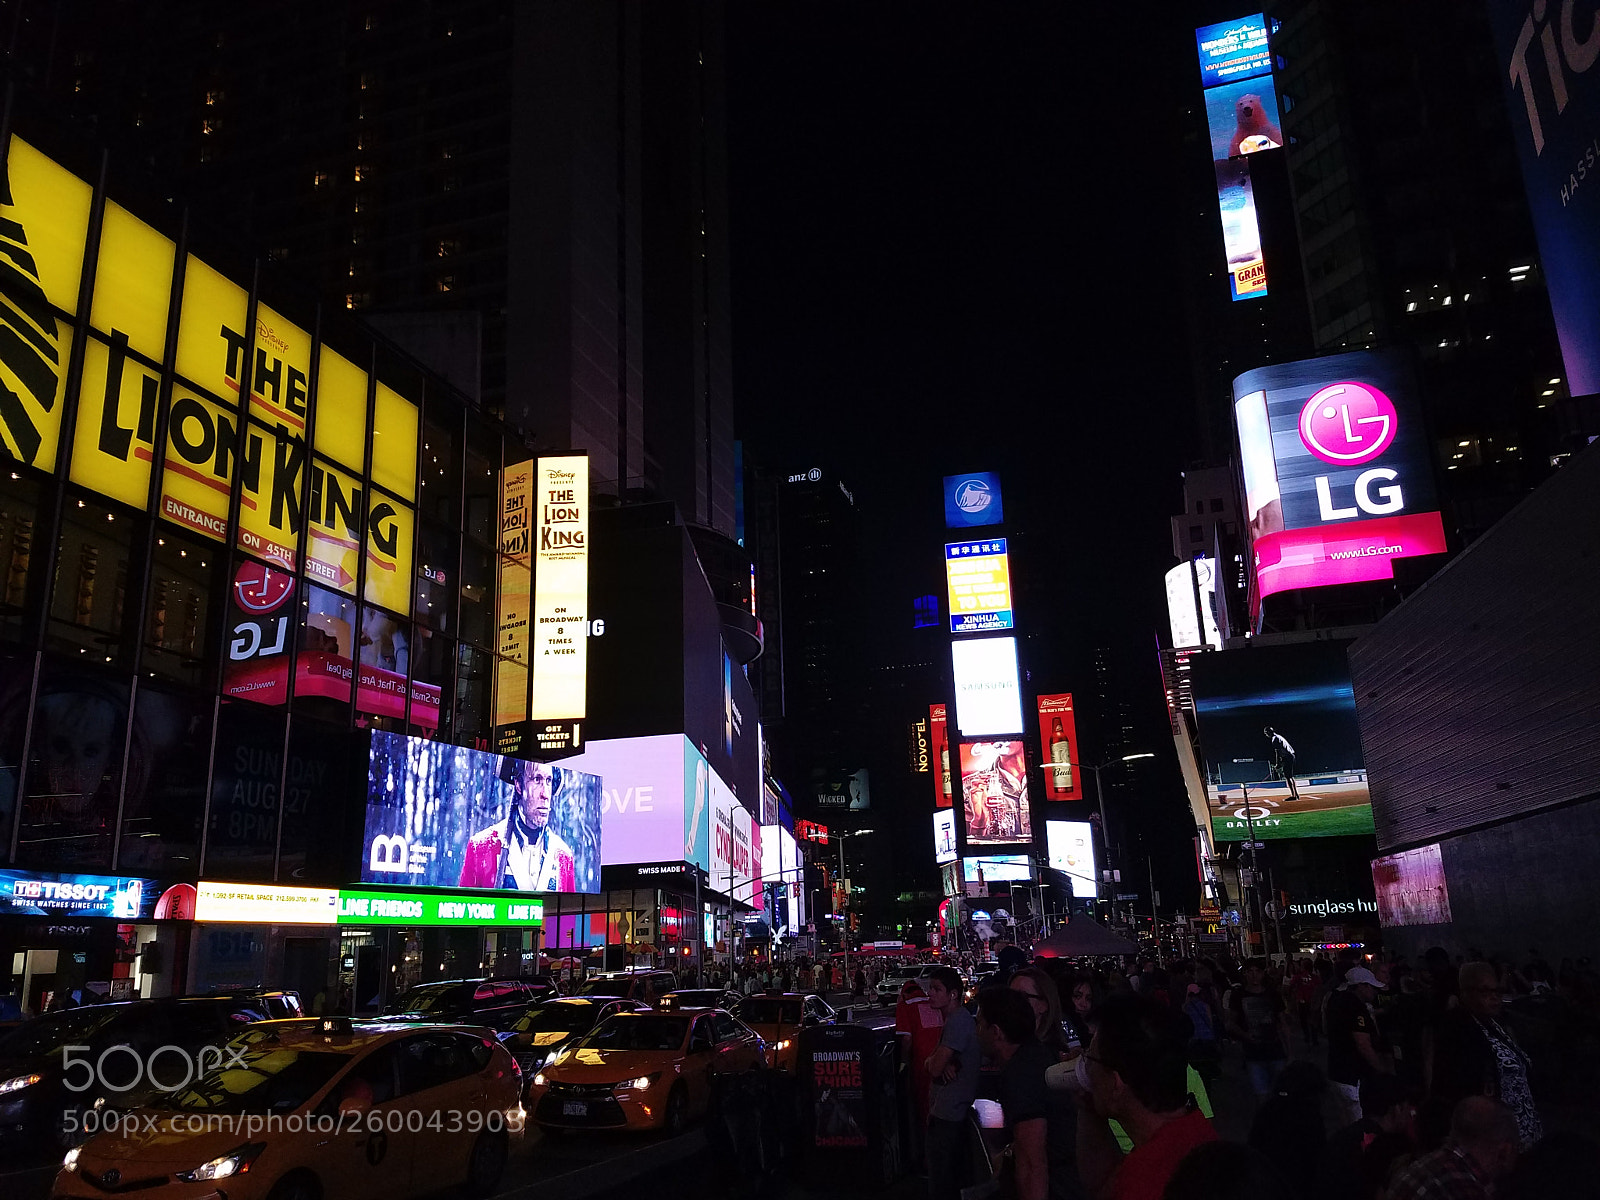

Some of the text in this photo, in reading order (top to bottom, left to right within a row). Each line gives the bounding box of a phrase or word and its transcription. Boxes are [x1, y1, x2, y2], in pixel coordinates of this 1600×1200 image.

[220, 324, 307, 418] THE
[98, 326, 262, 494] LION
[545, 469, 576, 480] Disney
[268, 421, 399, 560] KING
[548, 489, 574, 502] THE
[1314, 467, 1405, 522] LG
[544, 504, 579, 525] LION
[166, 499, 337, 580] ENTRANCE ON 45TH STREET
[541, 526, 584, 551] KING
[1330, 544, 1403, 561] www.LG.com
[539, 616, 584, 624] BROADWAY
[963, 613, 1000, 624] XINHUA
[557, 627, 564, 635] 8
[960, 680, 1014, 692] SAMSUNG
[545, 725, 563, 733] GET
[536, 732, 571, 741] TICKETS
[602, 786, 654, 815] VE
[638, 865, 682, 875] SWISS MADE
[42, 882, 110, 901] TISSOT
[256, 894, 274, 902] SPACE
[12, 899, 35, 907] SWISS
[37, 900, 69, 908] WATCHES
[71, 901, 91, 909] SINCE
[338, 897, 369, 917] LINE
[370, 898, 424, 918] FRIENDS
[438, 902, 466, 919] NEW
[467, 902, 496, 920] YORK
[507, 904, 530, 920] LINE
[1289, 898, 1377, 918] sunglass hu
[812, 1051, 861, 1062] BROADWAY'S
[814, 1061, 862, 1076] SURE
[815, 1076, 863, 1088] THING
